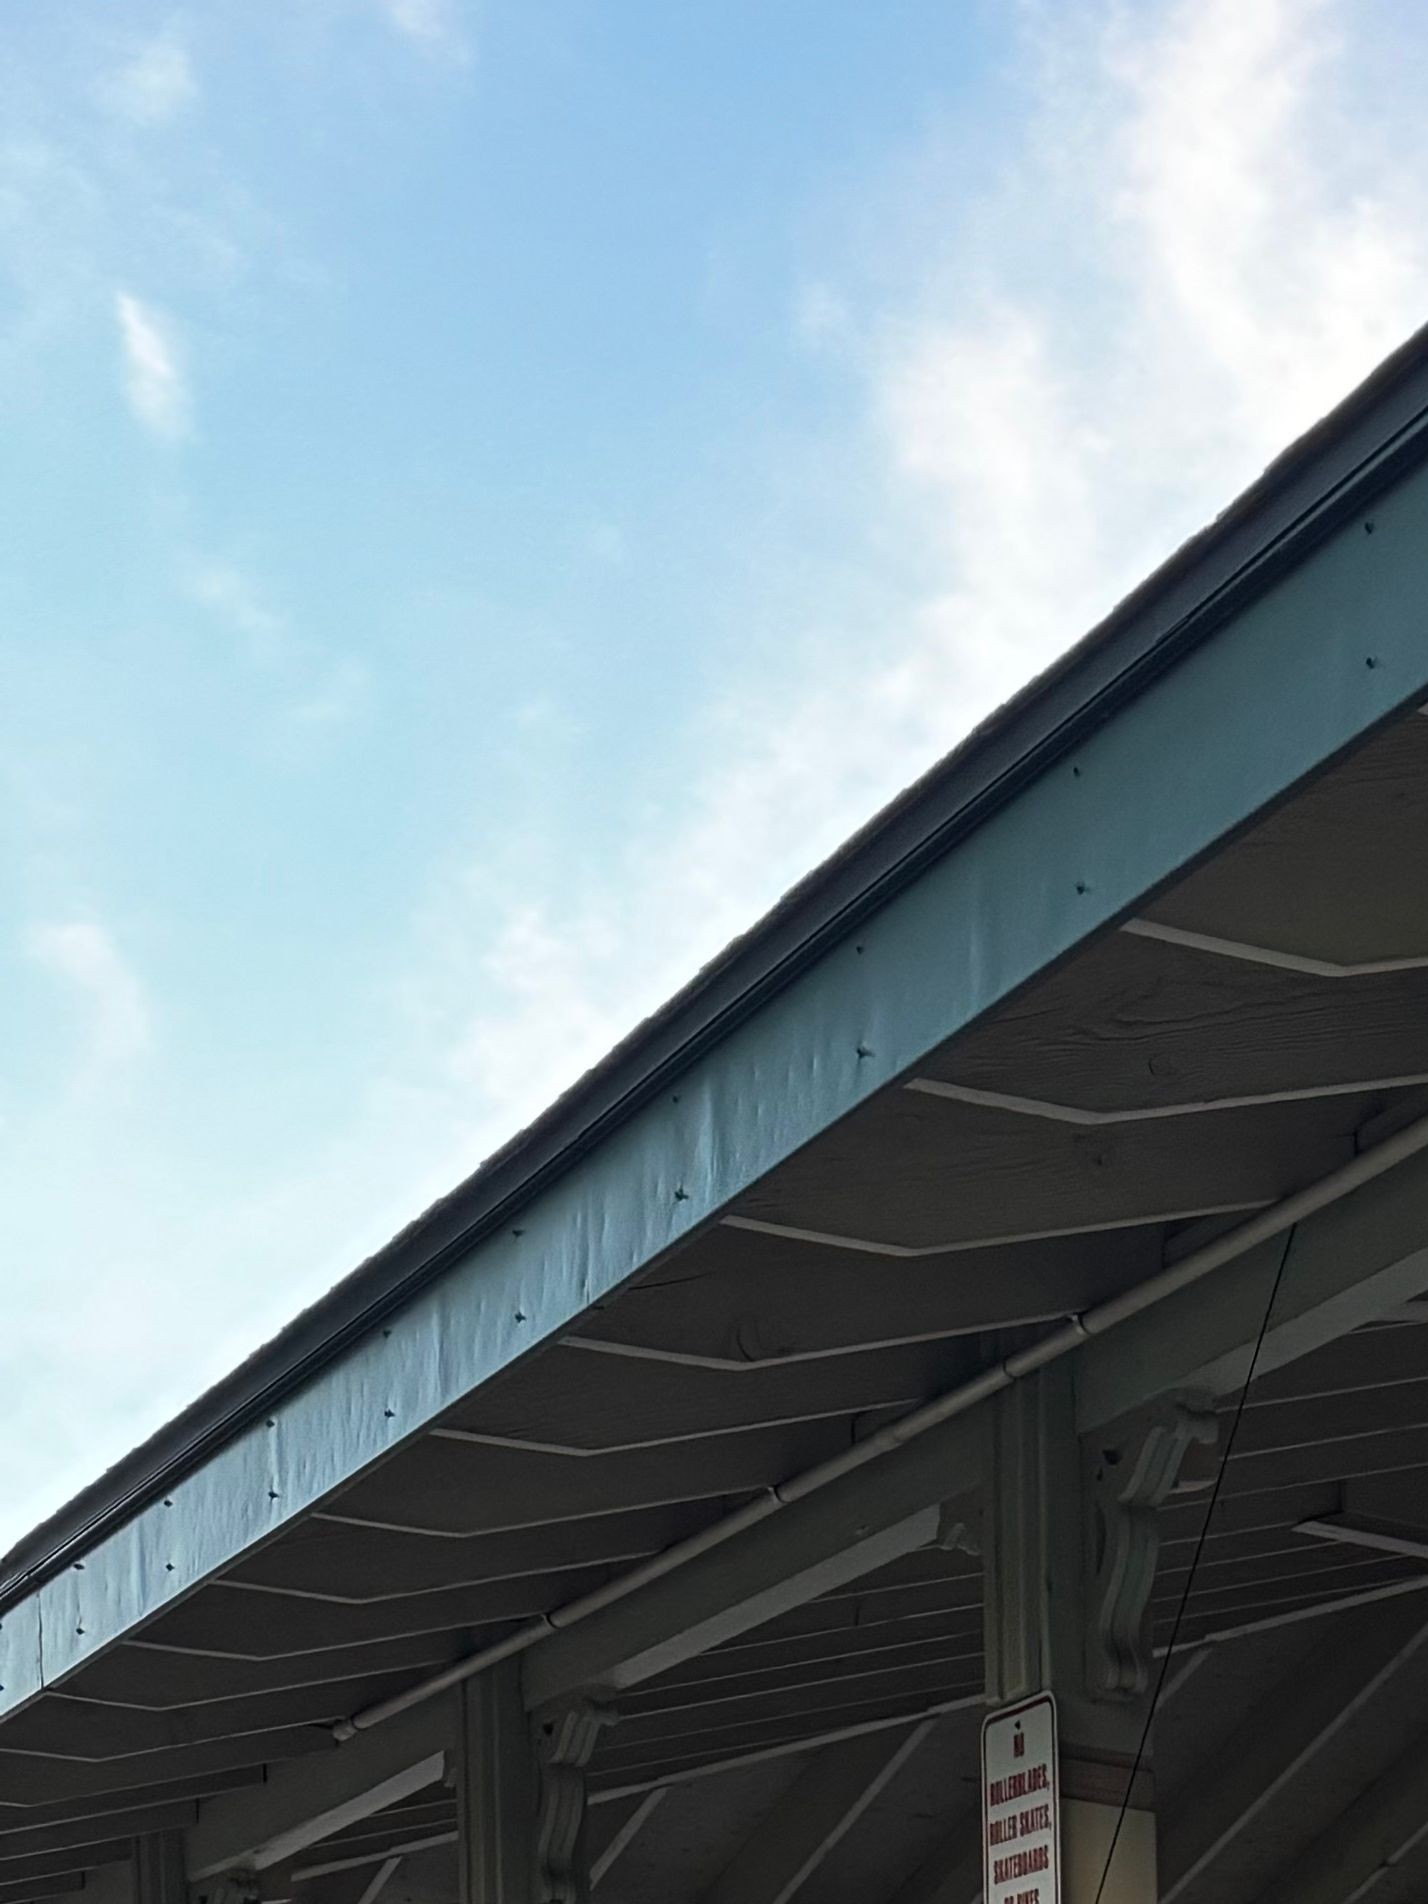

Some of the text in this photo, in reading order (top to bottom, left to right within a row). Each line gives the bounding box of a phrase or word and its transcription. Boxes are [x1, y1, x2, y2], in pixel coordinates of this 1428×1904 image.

[1013, 1732, 1024, 1758] NO
[990, 1763, 1050, 1806] ROLLERBLADES,
[990, 1804, 1052, 1846] ROLLER SKATES,
[994, 1844, 1049, 1884] SKATEBOARDS
